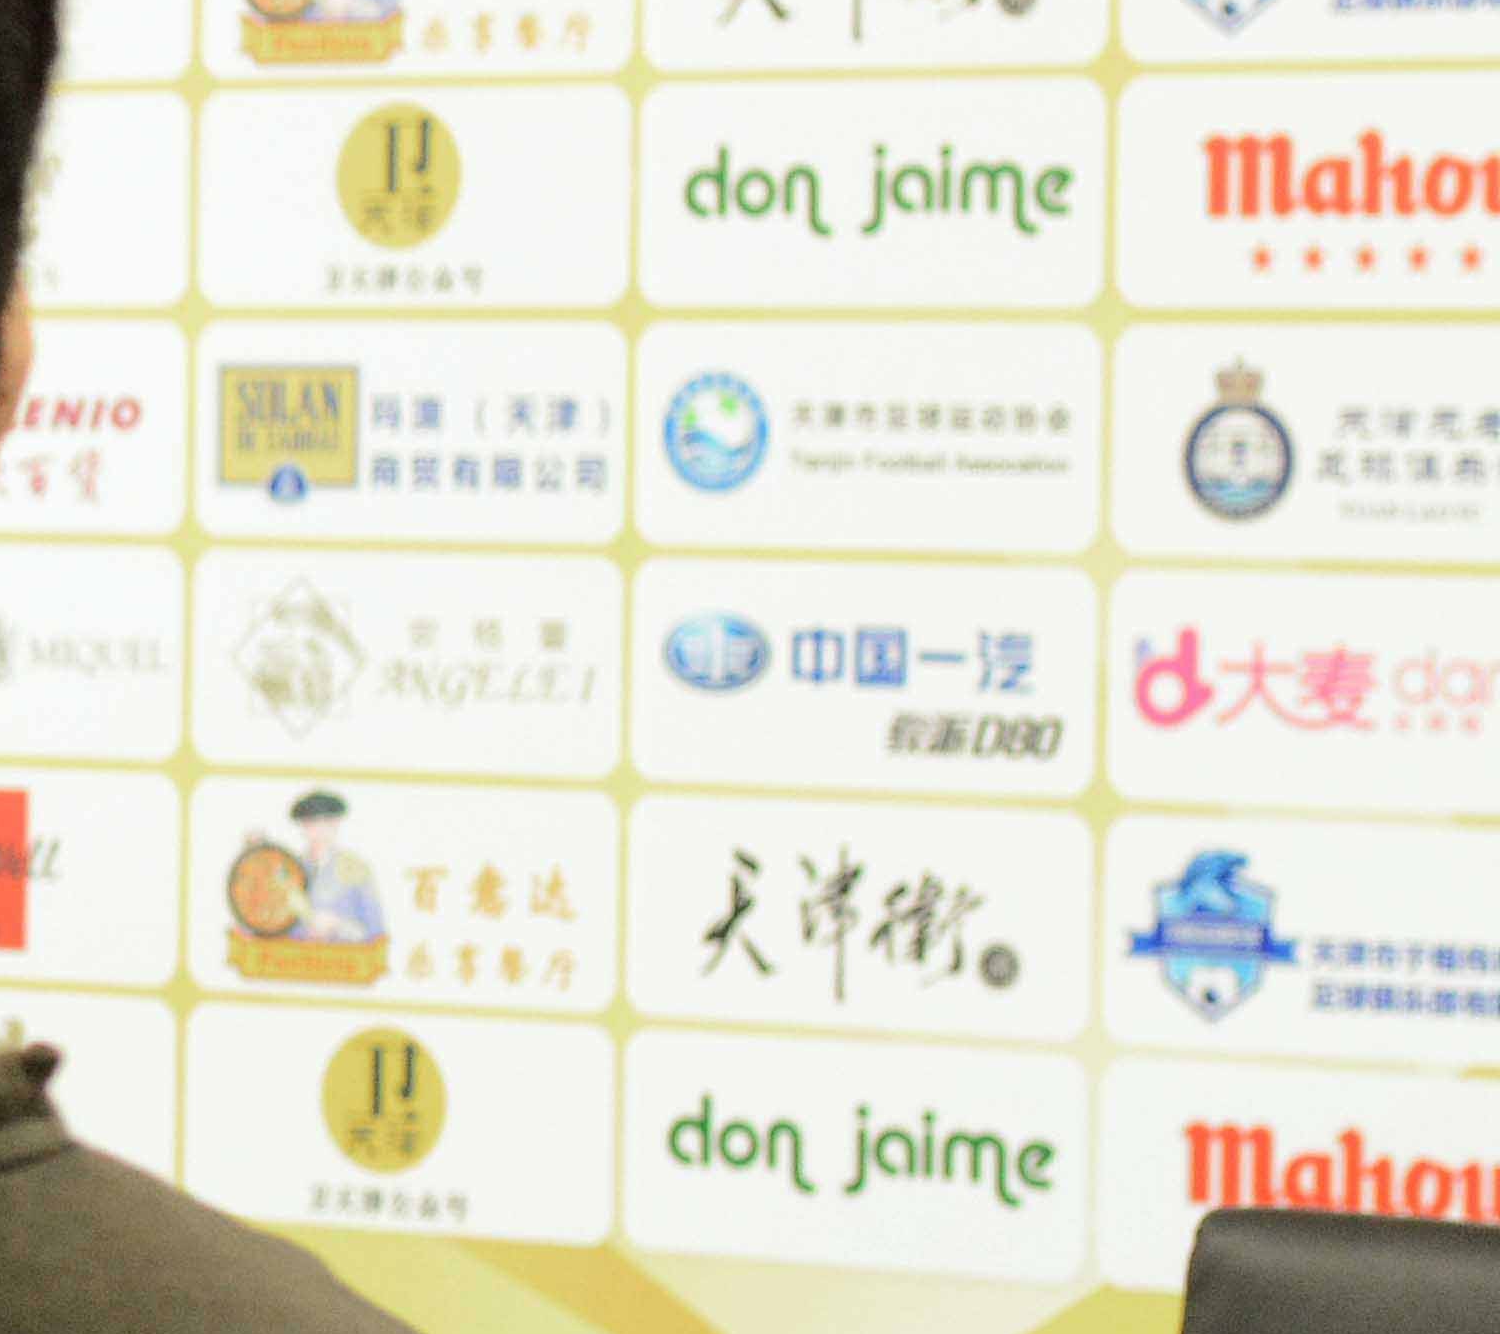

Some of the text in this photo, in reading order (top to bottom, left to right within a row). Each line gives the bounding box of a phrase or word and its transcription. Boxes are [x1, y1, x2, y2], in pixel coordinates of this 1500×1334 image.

[684, 144, 1074, 236] don jaime
[24, 396, 143, 434] ENIO
[791, 627, 1034, 692] 中国一汽
[1216, 643, 1377, 731] 大麦
[667, 1094, 1057, 1208] don jaime
